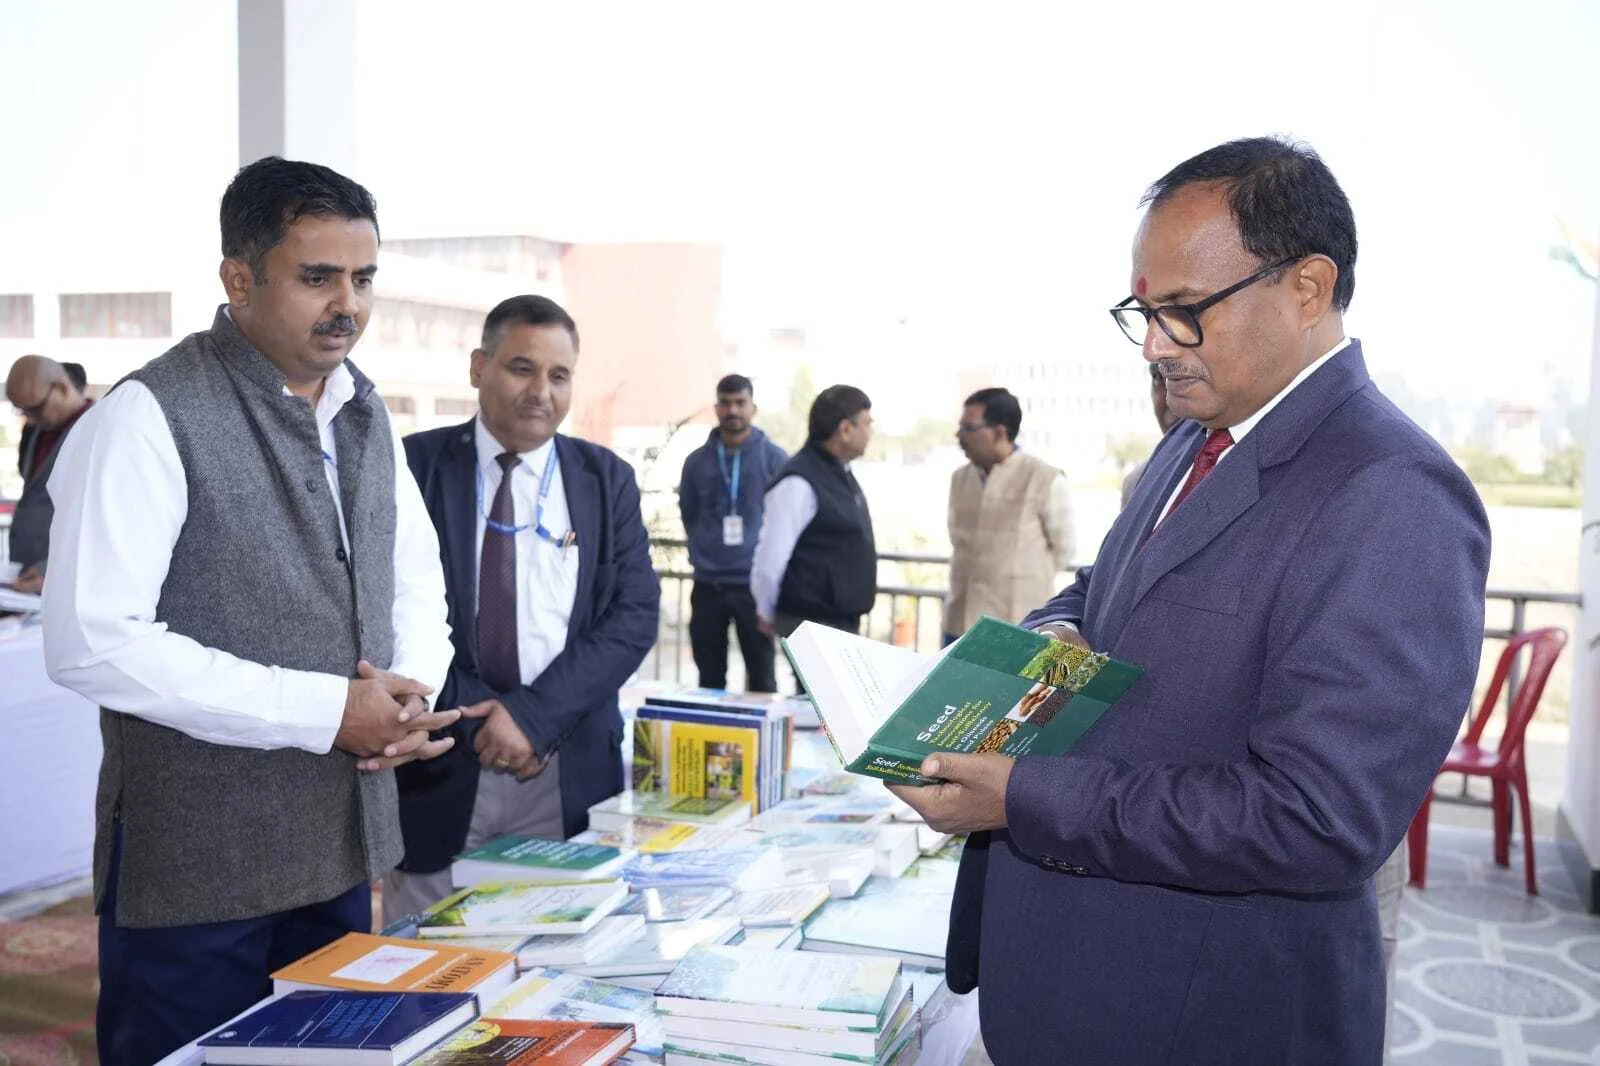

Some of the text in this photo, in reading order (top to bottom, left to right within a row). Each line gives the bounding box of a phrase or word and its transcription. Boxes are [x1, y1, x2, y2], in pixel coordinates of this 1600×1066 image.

[916, 704, 957, 742] Seed
[945, 701, 992, 748] Self-Sufficiency
[960, 716, 988, 743] Oilseeds
[872, 756, 901, 768] Seed
